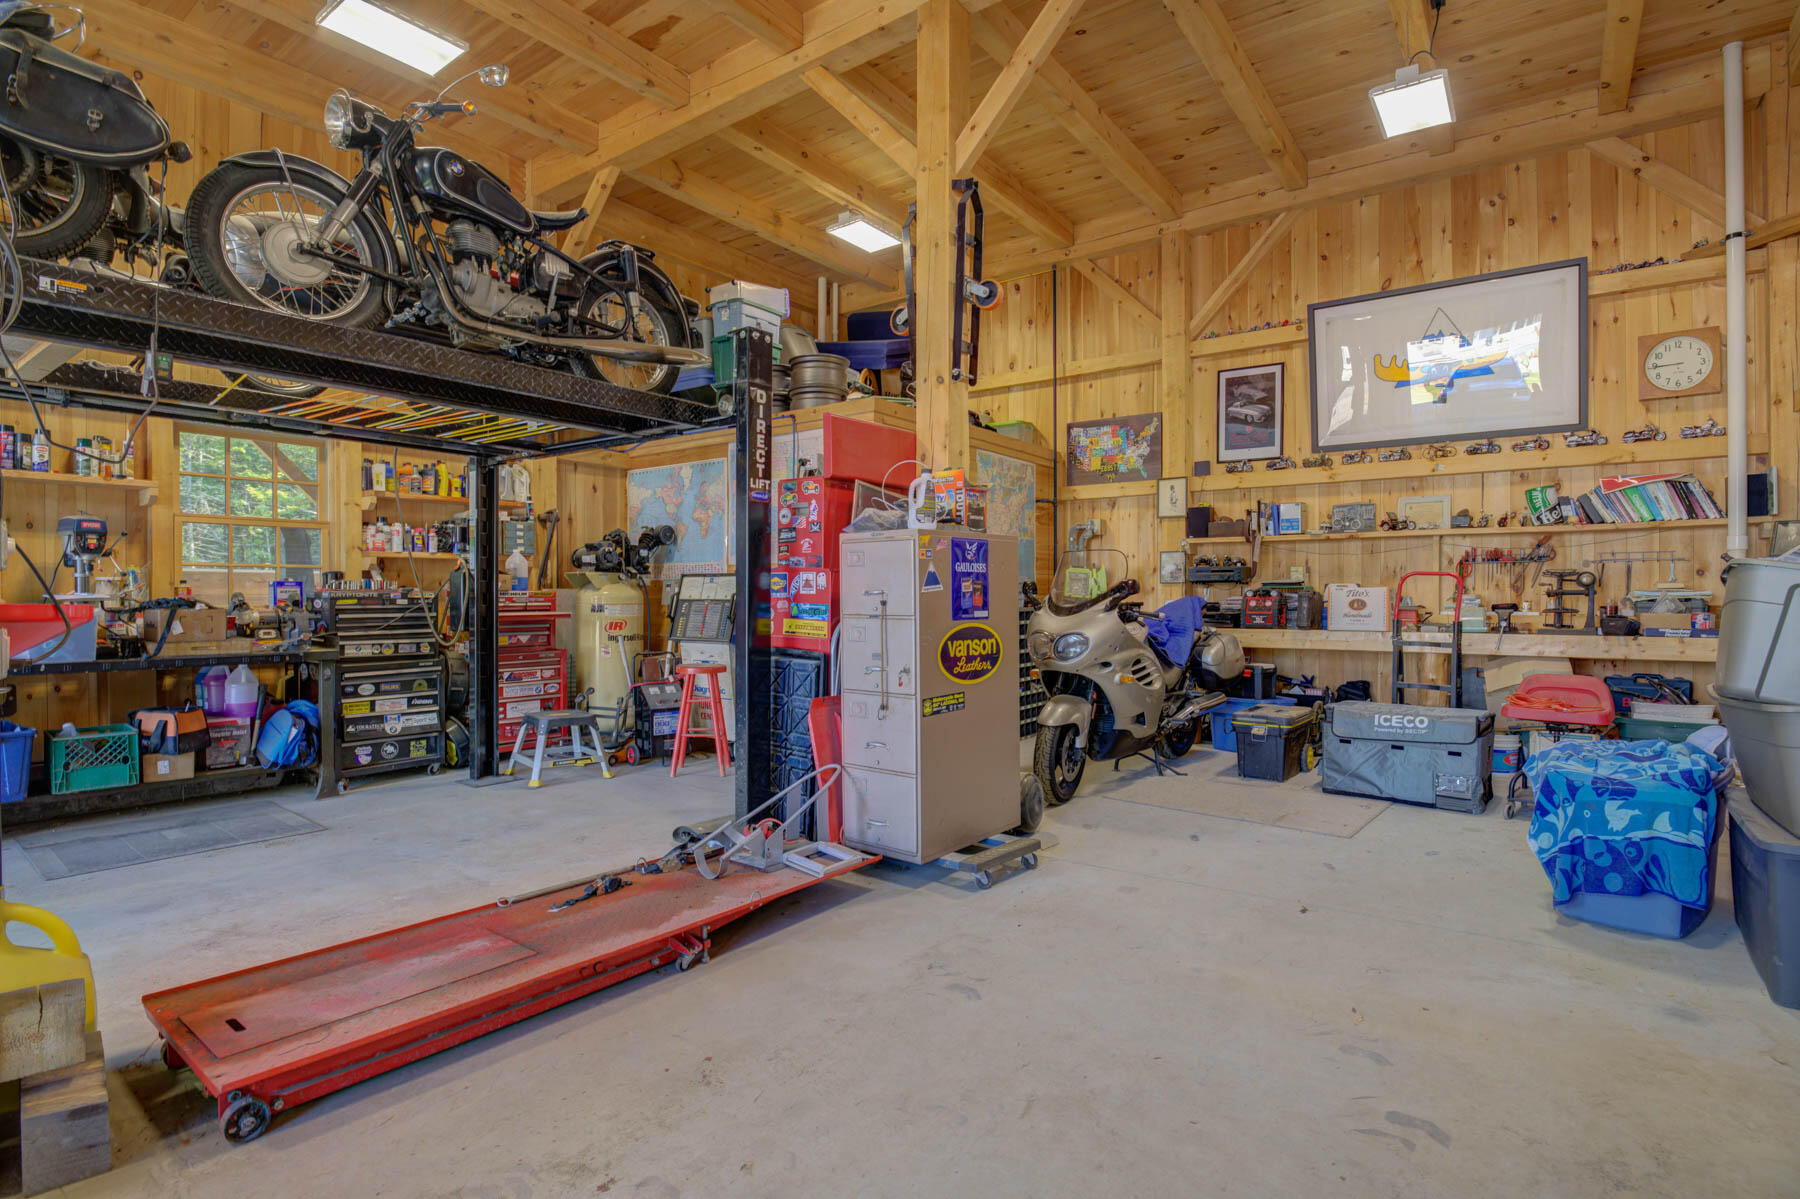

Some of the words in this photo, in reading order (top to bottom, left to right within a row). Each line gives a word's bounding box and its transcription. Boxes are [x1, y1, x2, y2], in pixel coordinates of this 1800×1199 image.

[1664, 344, 1671, 352] 11
[1674, 340, 1682, 349] 12
[1654, 352, 1663, 360] 10
[1696, 347, 1702, 356] 2
[1652, 362, 1658, 370] 9
[1700, 357, 1706, 366] 3
[1655, 372, 1661, 380] 8
[1687, 375, 1693, 383] 5
[1665, 377, 1671, 385] 7
[1675, 379, 1681, 387] 6
[755, 388, 767, 478] DIRECT
[750, 477, 771, 490] LIFT
[955, 561, 987, 573] GAULOISES
[1346, 589, 1370, 598] Tito's
[608, 621, 624, 631] IR
[947, 637, 997, 658] vanson
[953, 656, 992, 675] Leathers
[1374, 713, 1430, 729] ICECO
[1374, 726, 1397, 734] Powered
